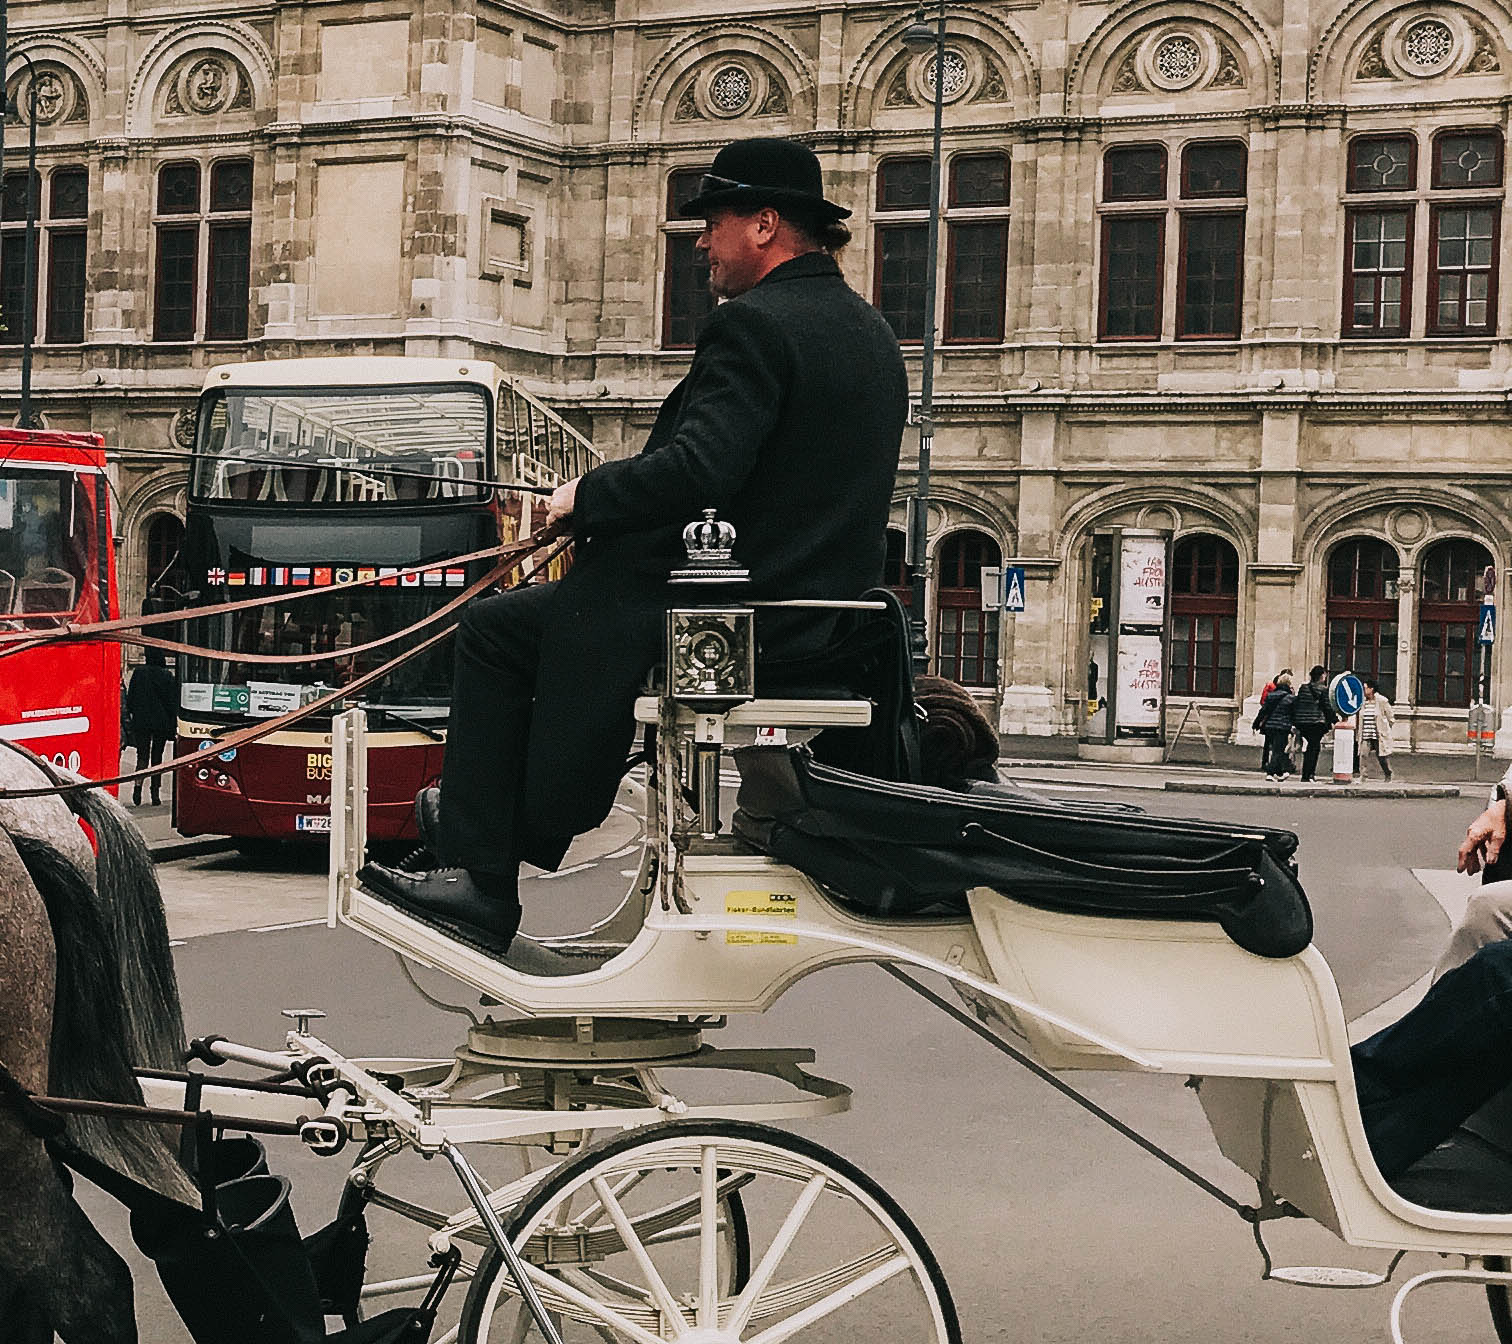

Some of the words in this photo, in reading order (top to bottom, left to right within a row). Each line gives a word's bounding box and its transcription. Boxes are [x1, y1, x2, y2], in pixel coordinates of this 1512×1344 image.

[307, 753, 333, 768] BIG
[306, 767, 333, 780] BUS
[306, 794, 332, 805] MA
